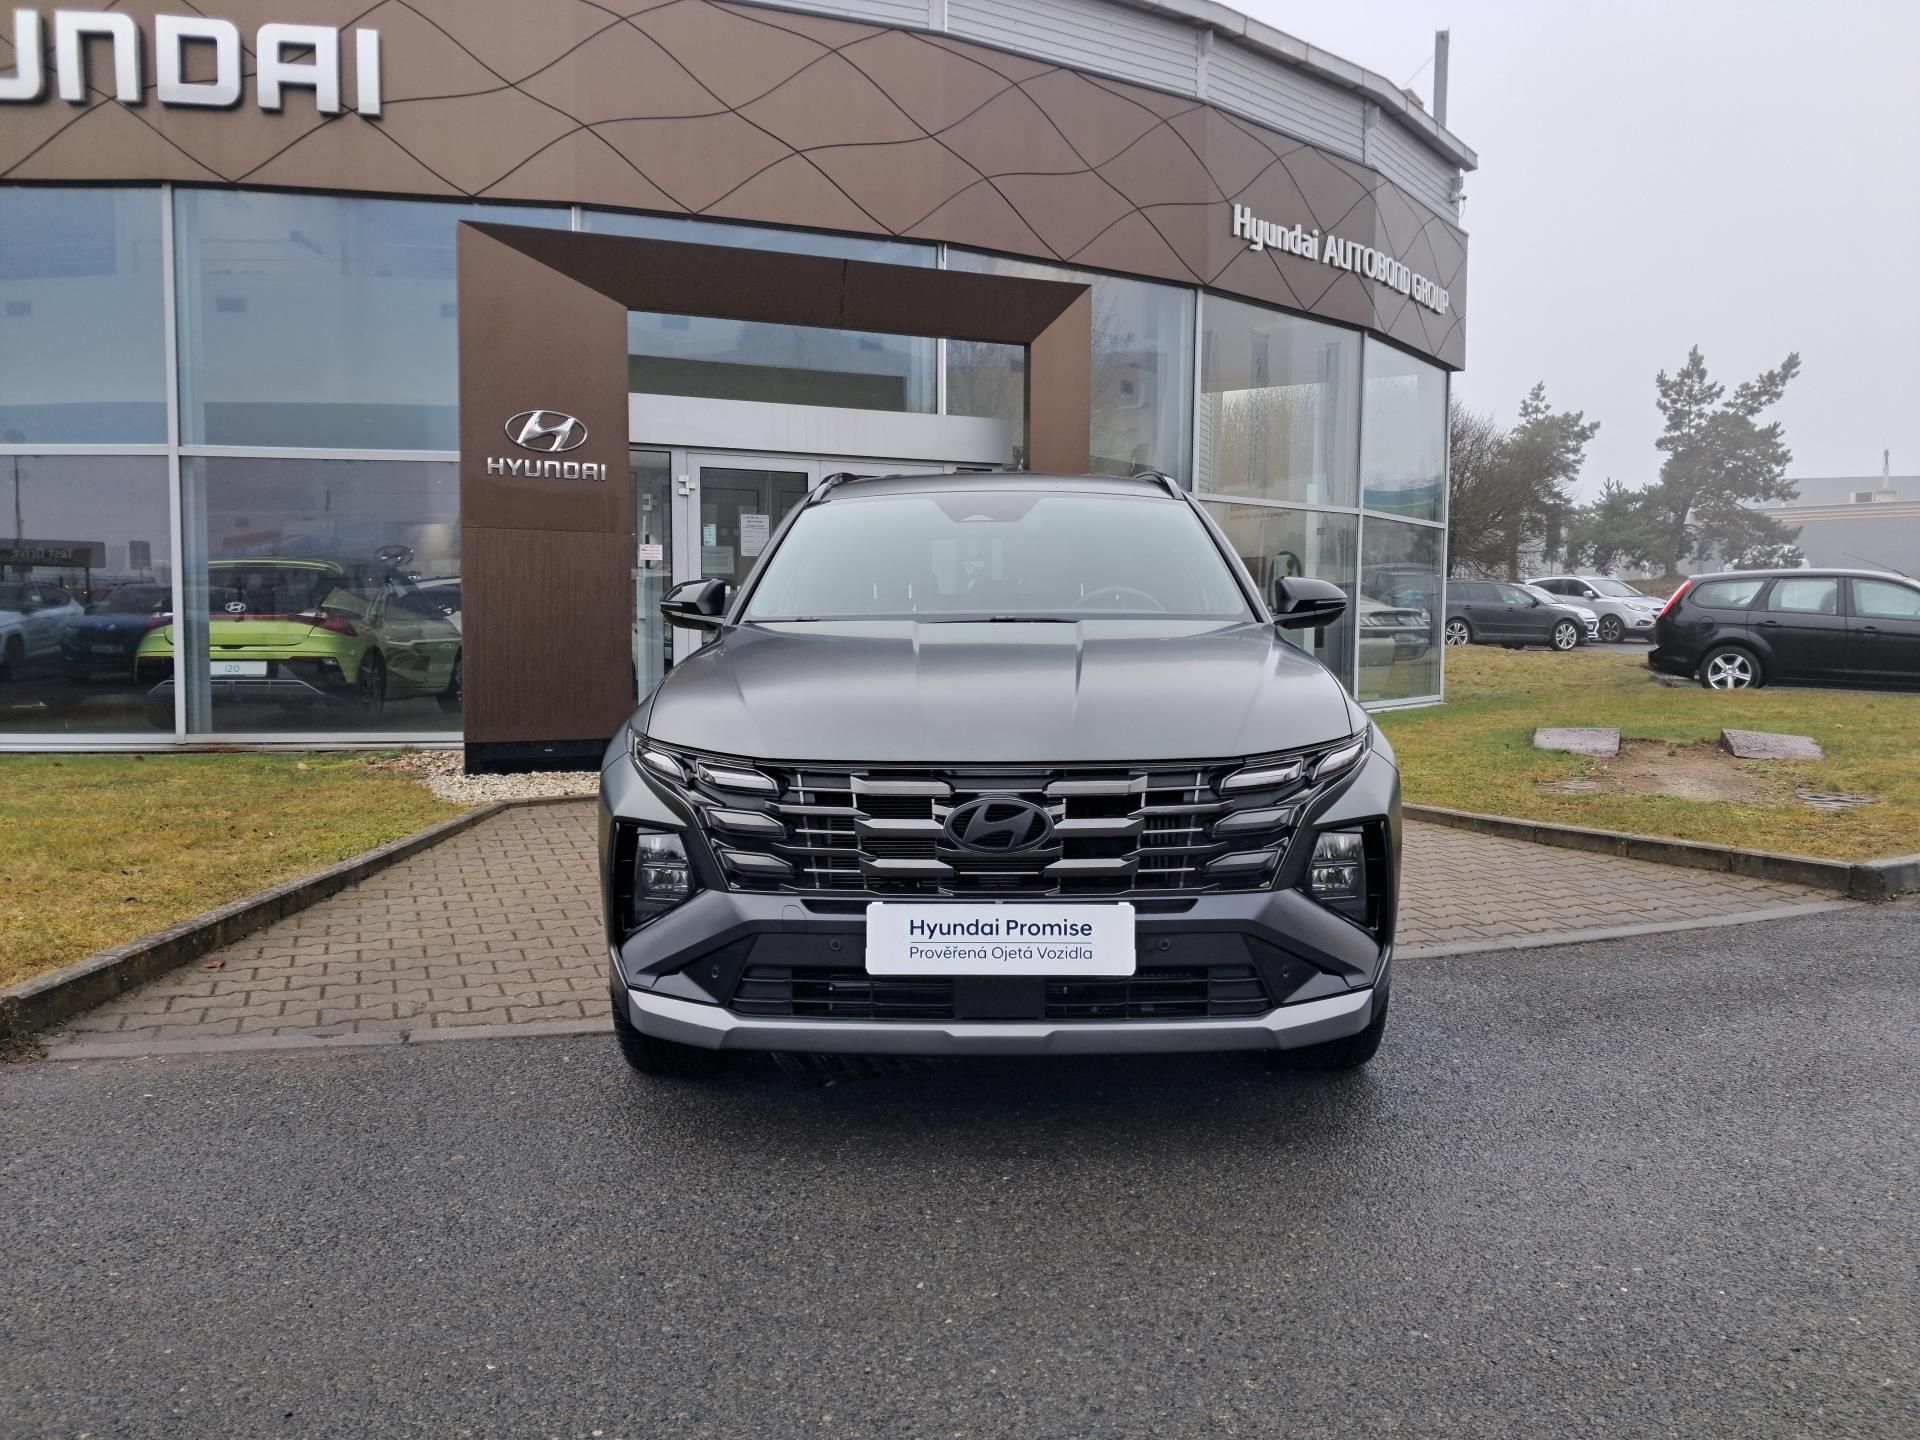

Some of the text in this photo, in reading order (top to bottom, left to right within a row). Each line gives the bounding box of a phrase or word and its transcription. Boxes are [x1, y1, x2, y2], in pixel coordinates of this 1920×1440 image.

[1233, 203, 1449, 315] Hyundai AUTOBOND GROUP
[487, 456, 606, 481] HYUNDAI
[224, 664, 240, 673] i20
[909, 918, 1093, 939] Hyundai Promise
[909, 946, 1093, 962] Prověřená Ojetá Vozidla
